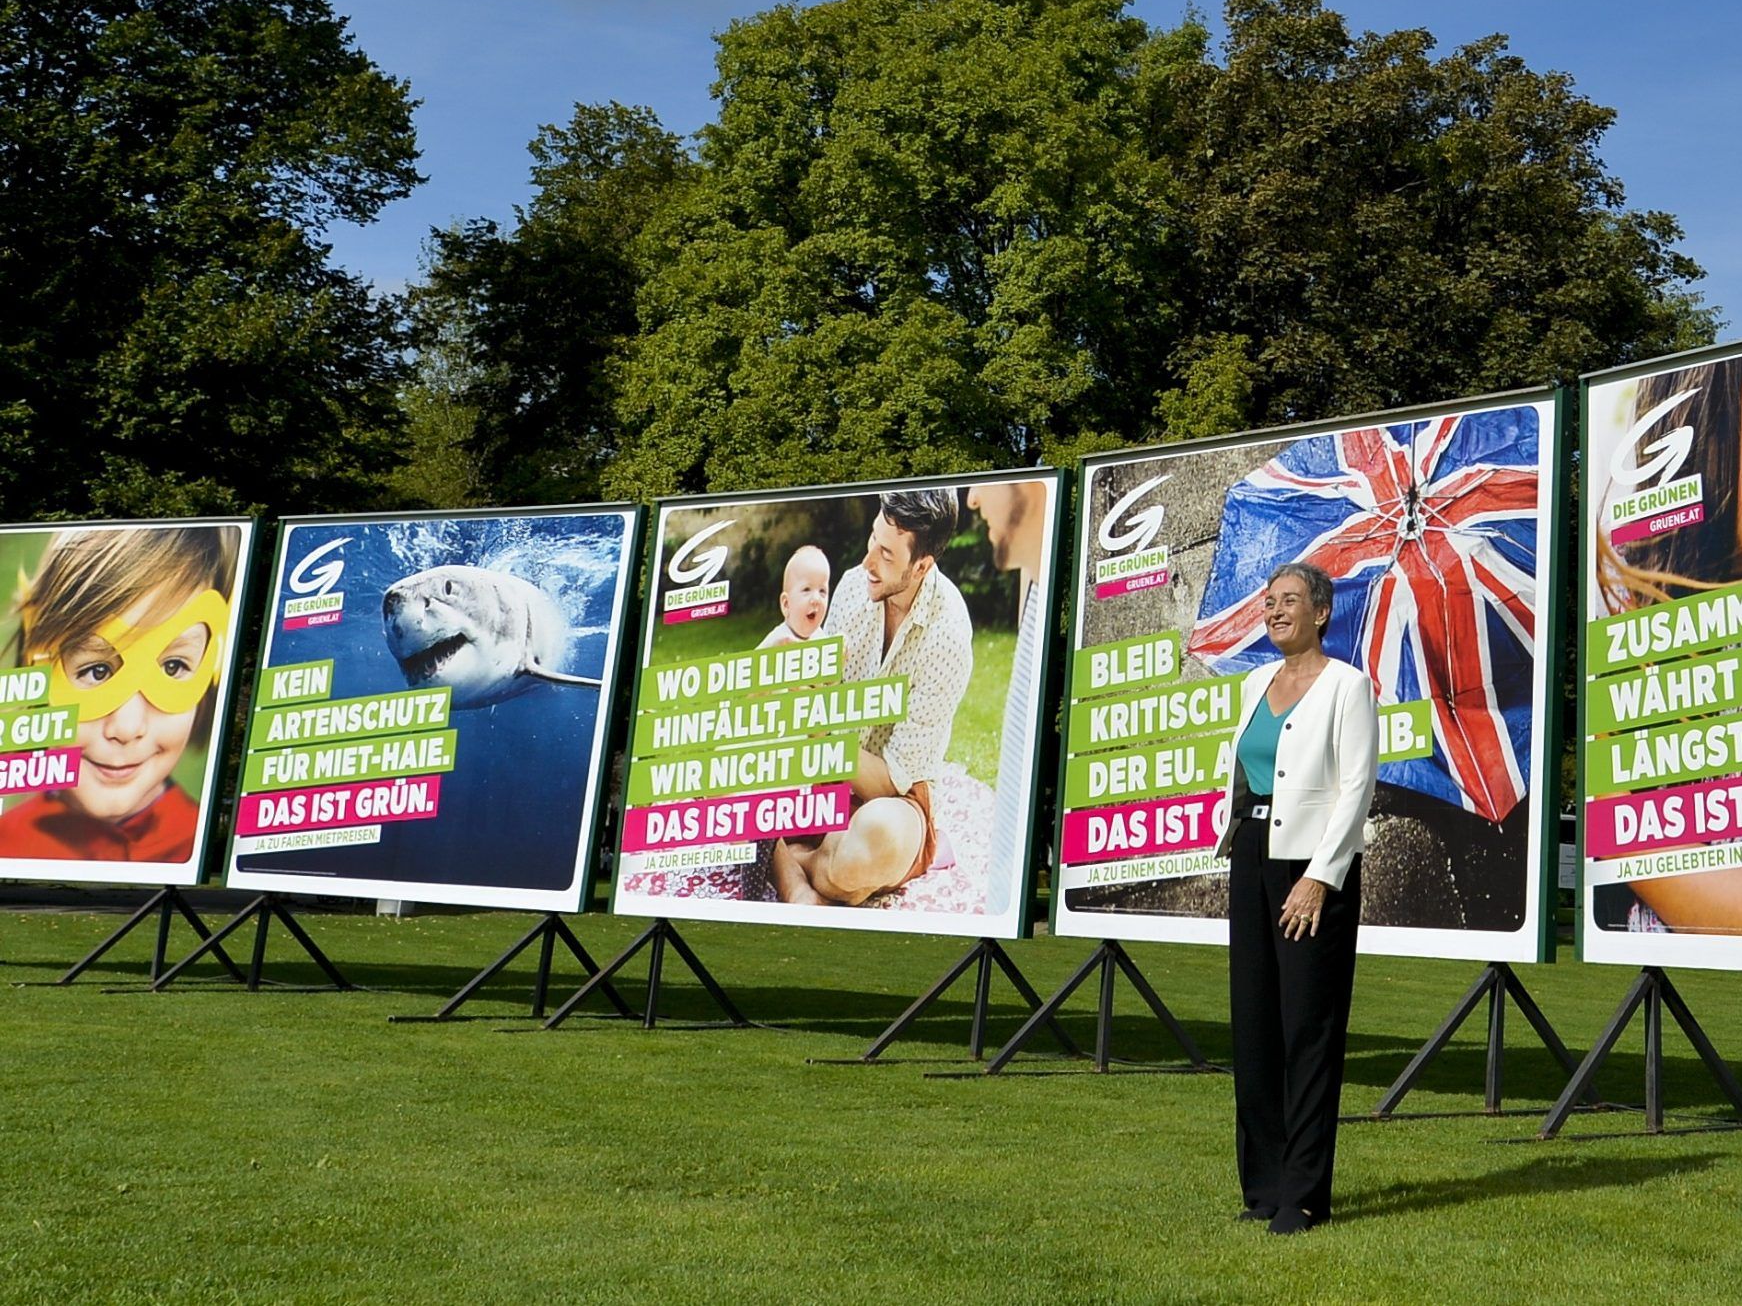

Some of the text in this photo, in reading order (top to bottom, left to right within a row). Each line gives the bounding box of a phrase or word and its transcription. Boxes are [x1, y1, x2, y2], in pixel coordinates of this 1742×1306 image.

[1613, 480, 1698, 520] DIE GRÜNEN
[1649, 508, 1700, 532] GRUENE.AT
[1100, 551, 1165, 578] DIE GRÜNEN
[1126, 573, 1166, 590] GRUENE.AT
[287, 596, 341, 613] DIE GRÜNEN
[667, 585, 726, 606] DIE GRÜNEN
[272, 666, 329, 700] KEIN
[657, 643, 838, 702] WO DIE LIEBE
[1090, 639, 1174, 689] BLEIB
[0, 672, 46, 703] IND
[1608, 657, 1739, 723] WÄHRT
[11, 711, 73, 744] GUT.
[266, 693, 447, 742] ARTENSCHUTZ
[653, 682, 904, 749] HINFÄLLT, FALLEN
[1090, 683, 1231, 743] KRITISCH
[262, 737, 450, 785] FÜR MIET-HAIE.
[650, 741, 853, 796] WIR NICHT UM.
[1089, 754, 1148, 798] DER
[1155, 746, 1204, 788] EU.
[1378, 711, 1426, 754] IB.
[257, 778, 434, 828] DAS IST GRÜN.
[646, 784, 844, 844] DAS IST GRÜN.
[1614, 795, 1686, 846] DAS
[255, 828, 378, 851] JA ZU FAIREN MIETPREISEN.
[1087, 808, 1148, 854] DAS
[1155, 801, 1203, 846] IST
[644, 847, 753, 869] JA ZUR EHE FÜR ALLE.
[1087, 855, 1228, 883] JA ZU EINEM SOLIDARISC
[1617, 861, 1632, 879] JA
[1636, 857, 1652, 876] ZU
[1656, 849, 1725, 874] GELEBTER
